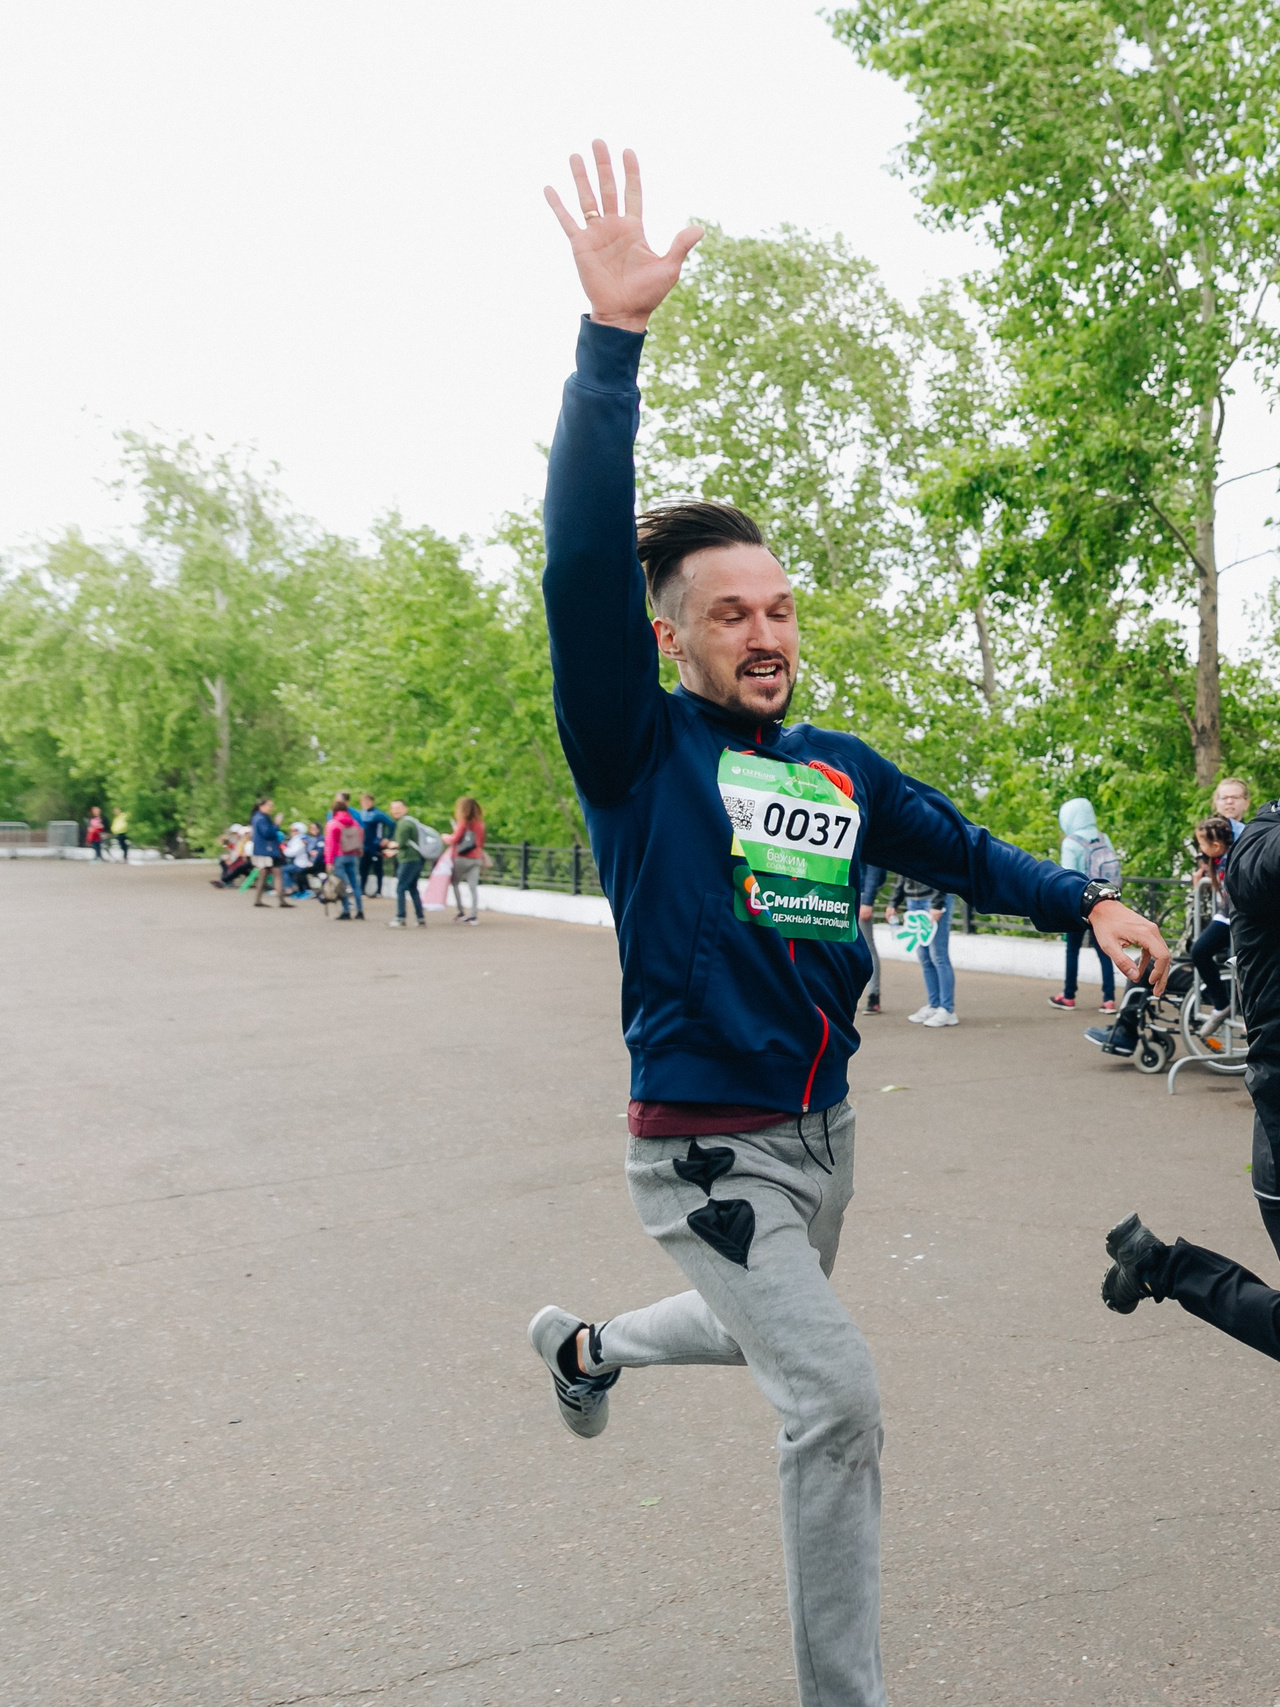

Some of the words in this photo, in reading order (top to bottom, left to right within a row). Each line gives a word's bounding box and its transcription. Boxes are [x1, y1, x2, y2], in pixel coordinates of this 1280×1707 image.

[763, 802, 851, 849] 0037
[766, 848, 806, 867] бежим
[762, 891, 850, 914] СмитИнвест
